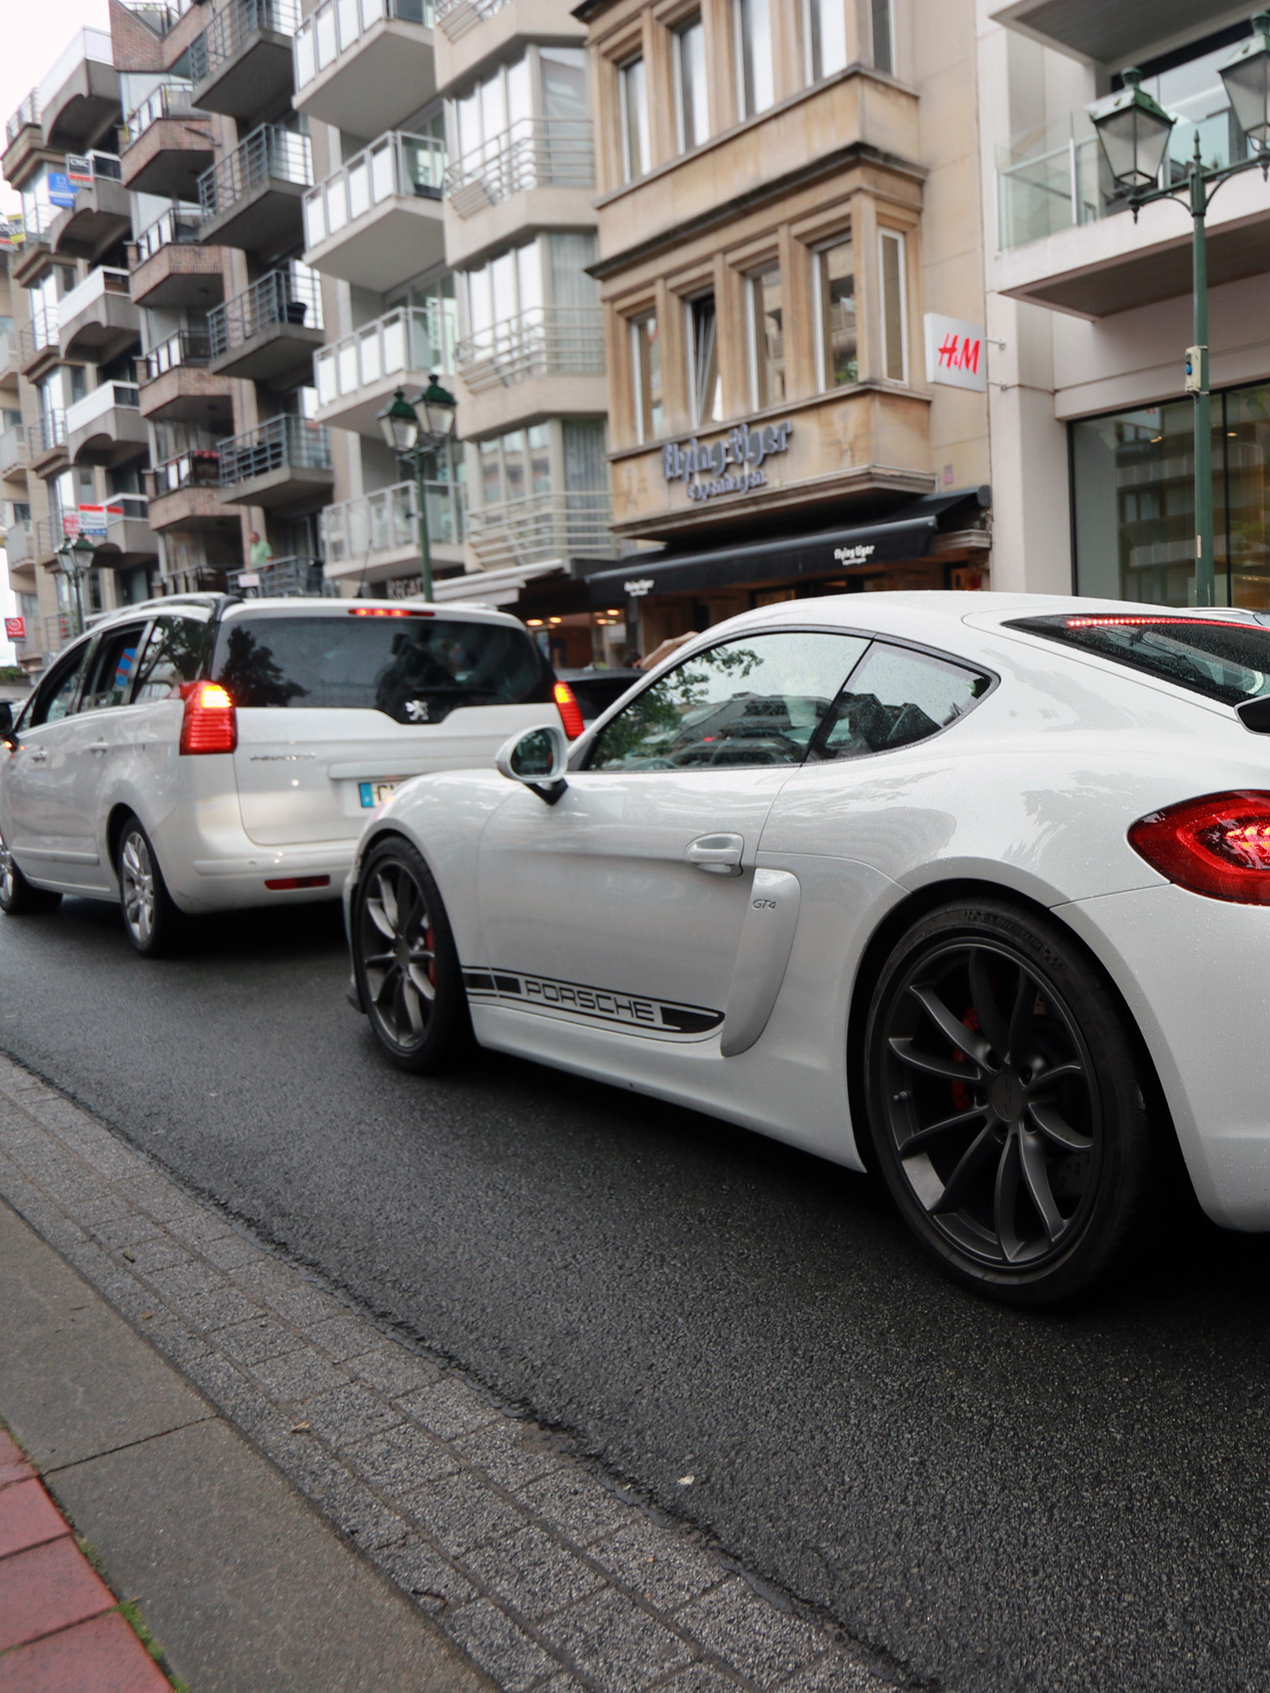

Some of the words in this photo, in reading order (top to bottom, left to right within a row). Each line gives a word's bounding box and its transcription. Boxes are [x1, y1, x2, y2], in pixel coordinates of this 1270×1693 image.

[938, 332, 981, 375] H&M
[661, 437, 726, 483] flying
[727, 420, 792, 466] tiger
[752, 898, 777, 910] GT4
[525, 980, 655, 1022] PORSCHE
